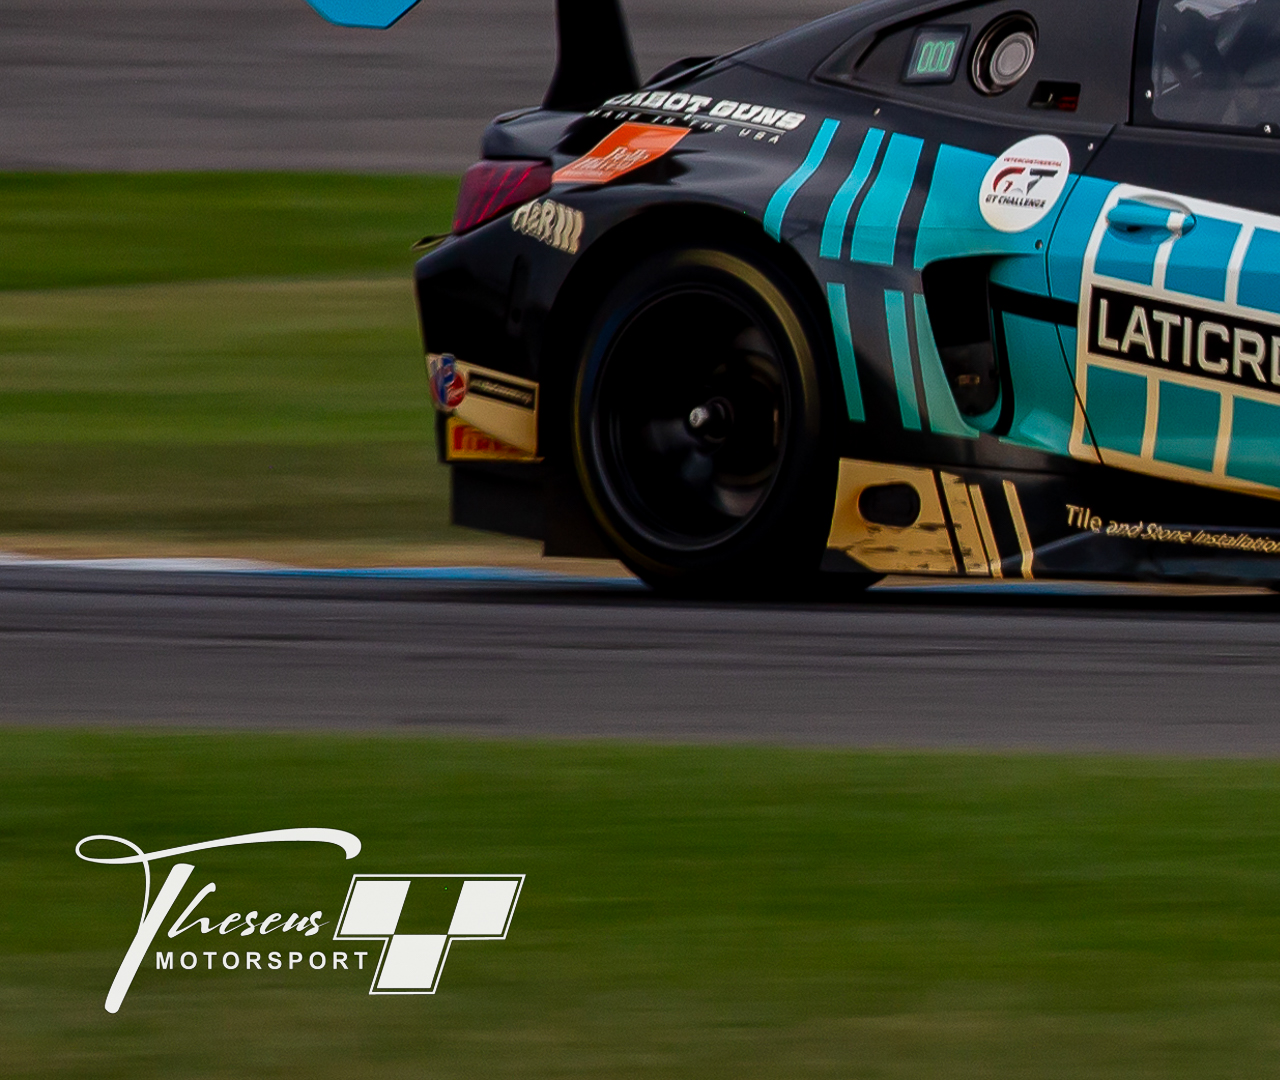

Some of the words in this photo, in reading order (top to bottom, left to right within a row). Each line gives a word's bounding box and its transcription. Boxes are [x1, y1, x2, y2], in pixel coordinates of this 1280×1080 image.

[738, 128, 783, 145] USA
[998, 195, 1047, 209] CHALLENGE
[1066, 504, 1103, 534] Tile
[1106, 521, 1143, 539] and
[1141, 523, 1193, 544] Stone
